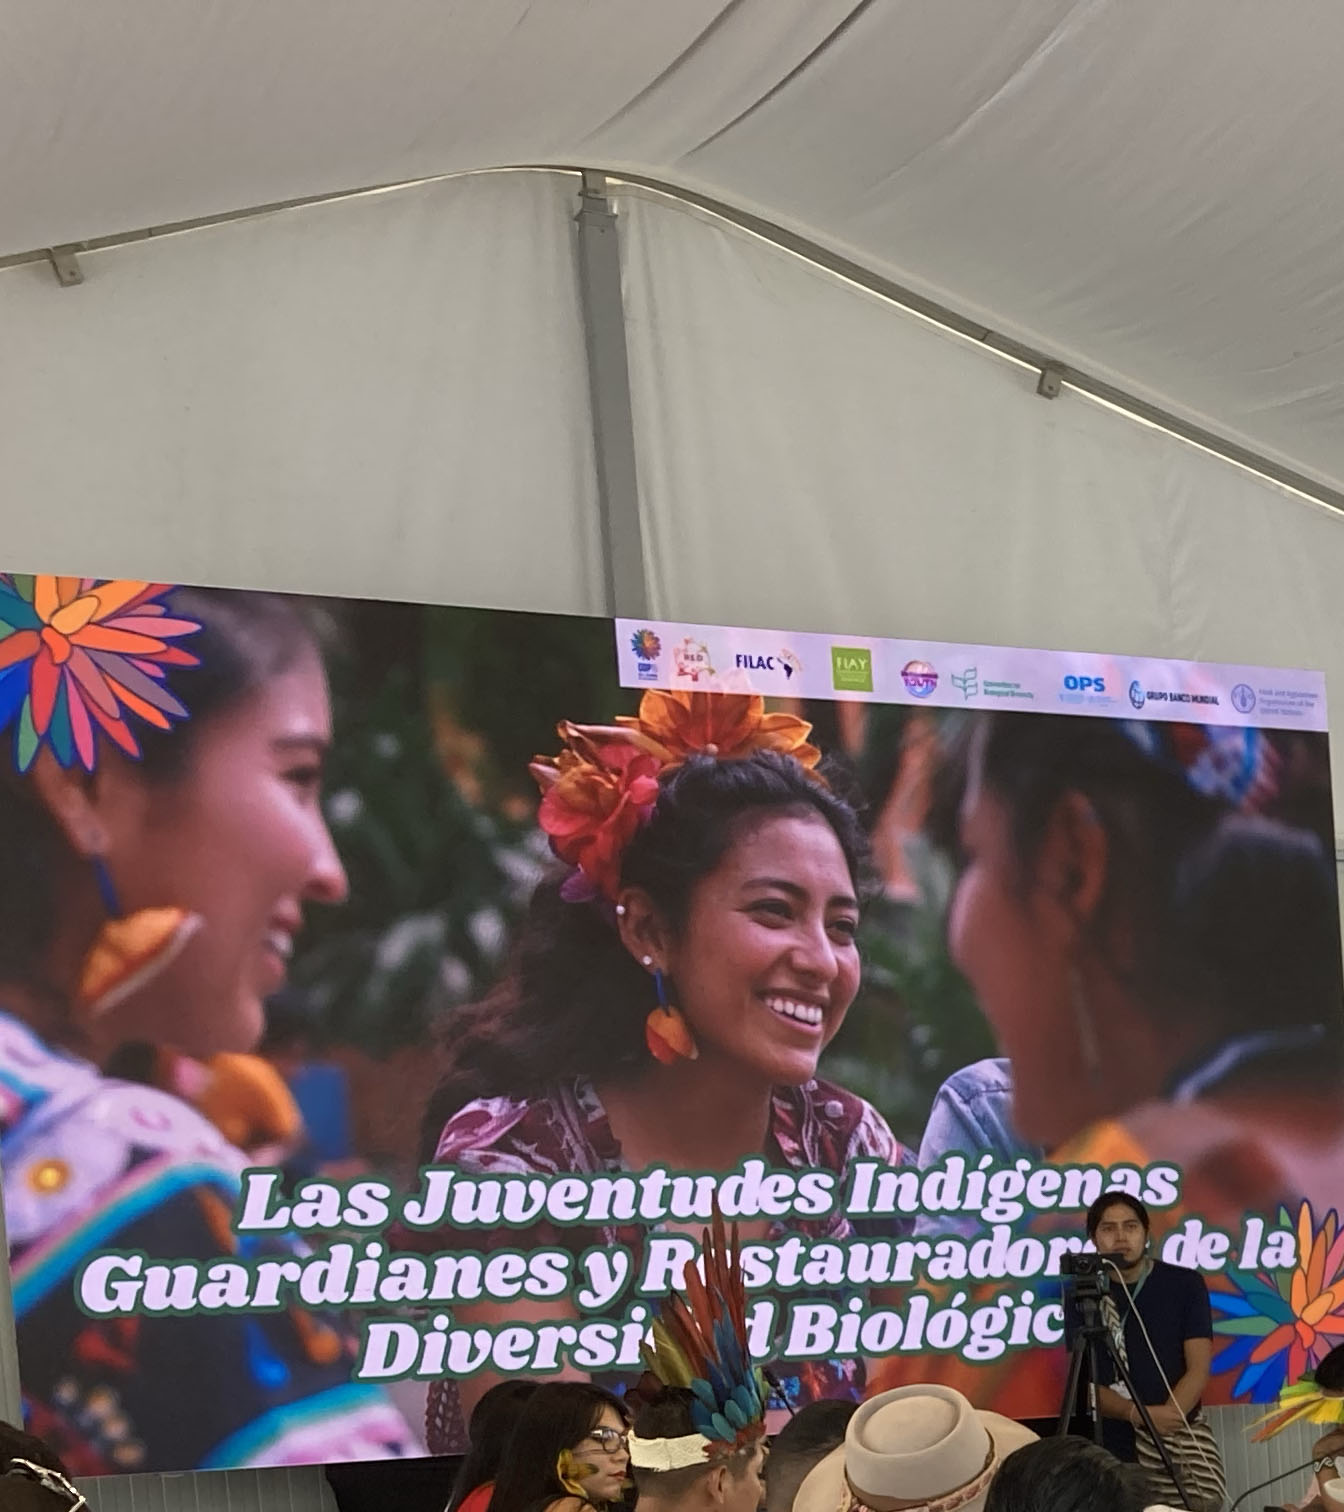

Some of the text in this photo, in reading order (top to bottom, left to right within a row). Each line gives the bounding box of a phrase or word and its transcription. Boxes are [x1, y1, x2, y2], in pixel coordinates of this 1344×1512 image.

[735, 654, 775, 670] FILAC
[1063, 675, 1106, 692] OPS
[1146, 691, 1220, 706] GRUPO BANCO MUNDIAL
[238, 1154, 1180, 1229] Las Juventudes Indígenas
[80, 1217, 1297, 1313] Guardianes y Rstaurador de la
[358, 1291, 1064, 1378] Diversid Biológic
